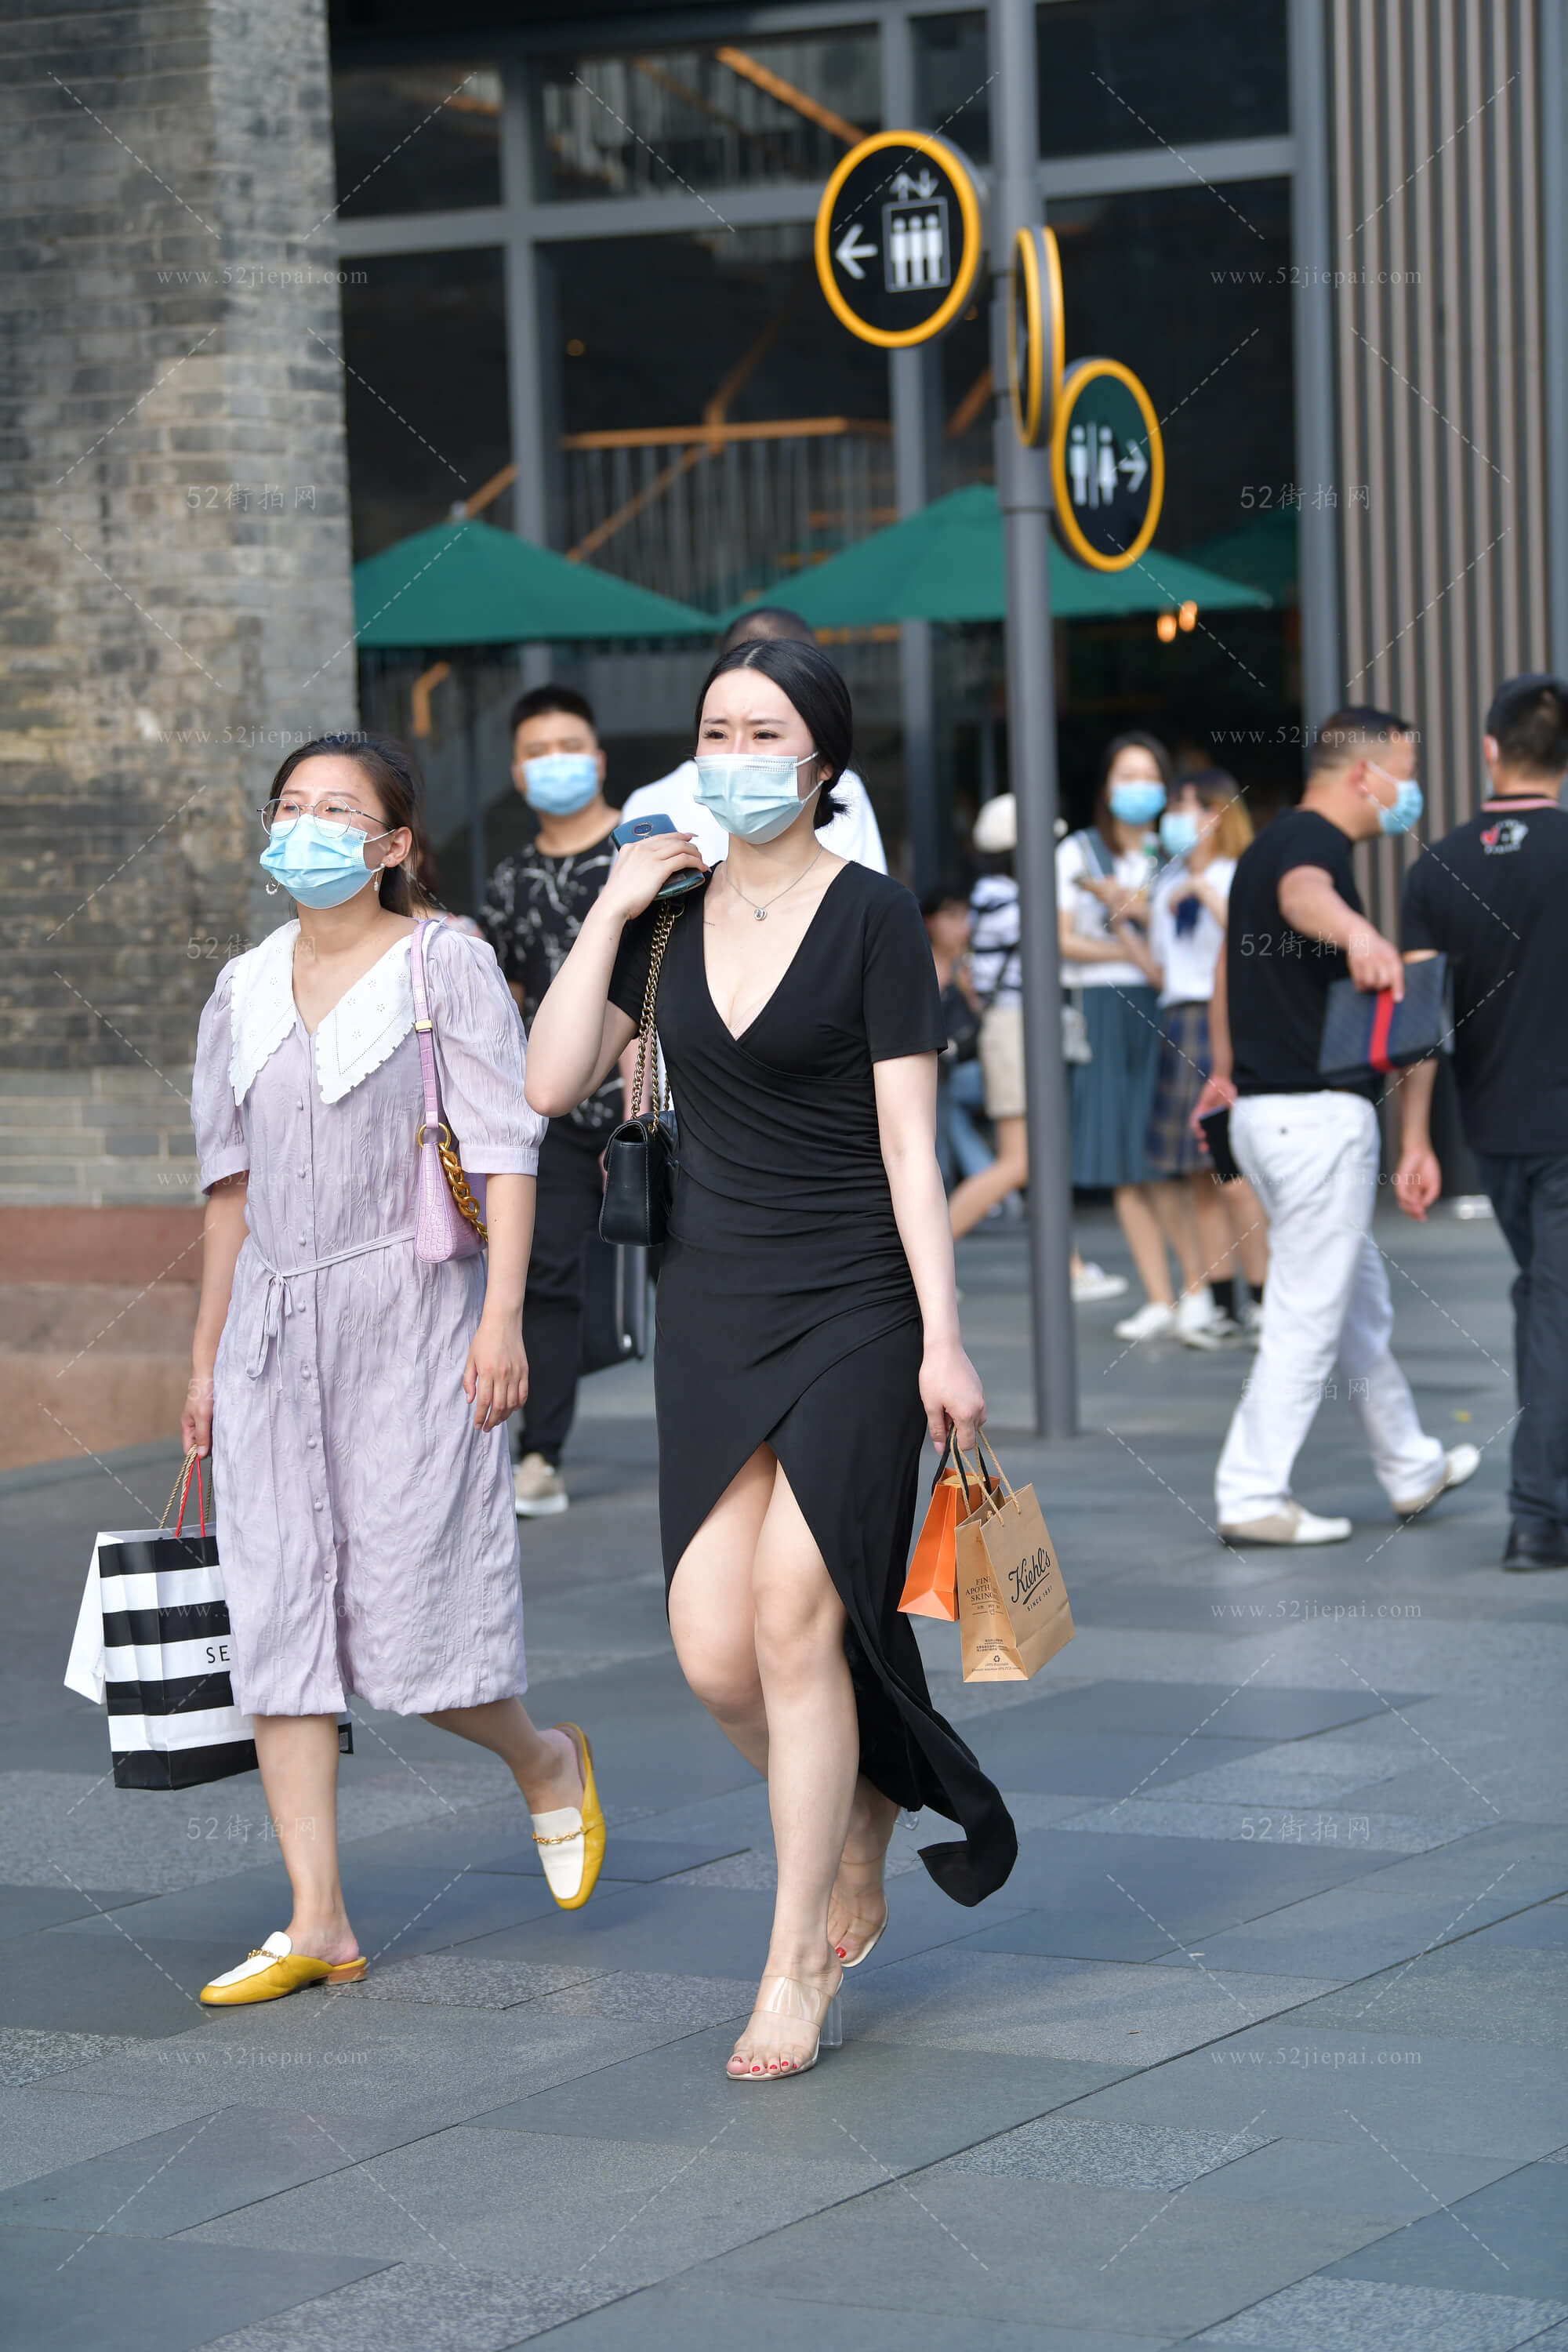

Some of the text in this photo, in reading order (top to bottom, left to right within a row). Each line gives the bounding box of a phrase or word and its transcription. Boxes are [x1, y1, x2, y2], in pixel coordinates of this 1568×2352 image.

[975, 1576, 990, 1585] FIN
[1008, 1547, 1051, 1603] Kiehl's
[206, 1645, 230, 1664] SE
